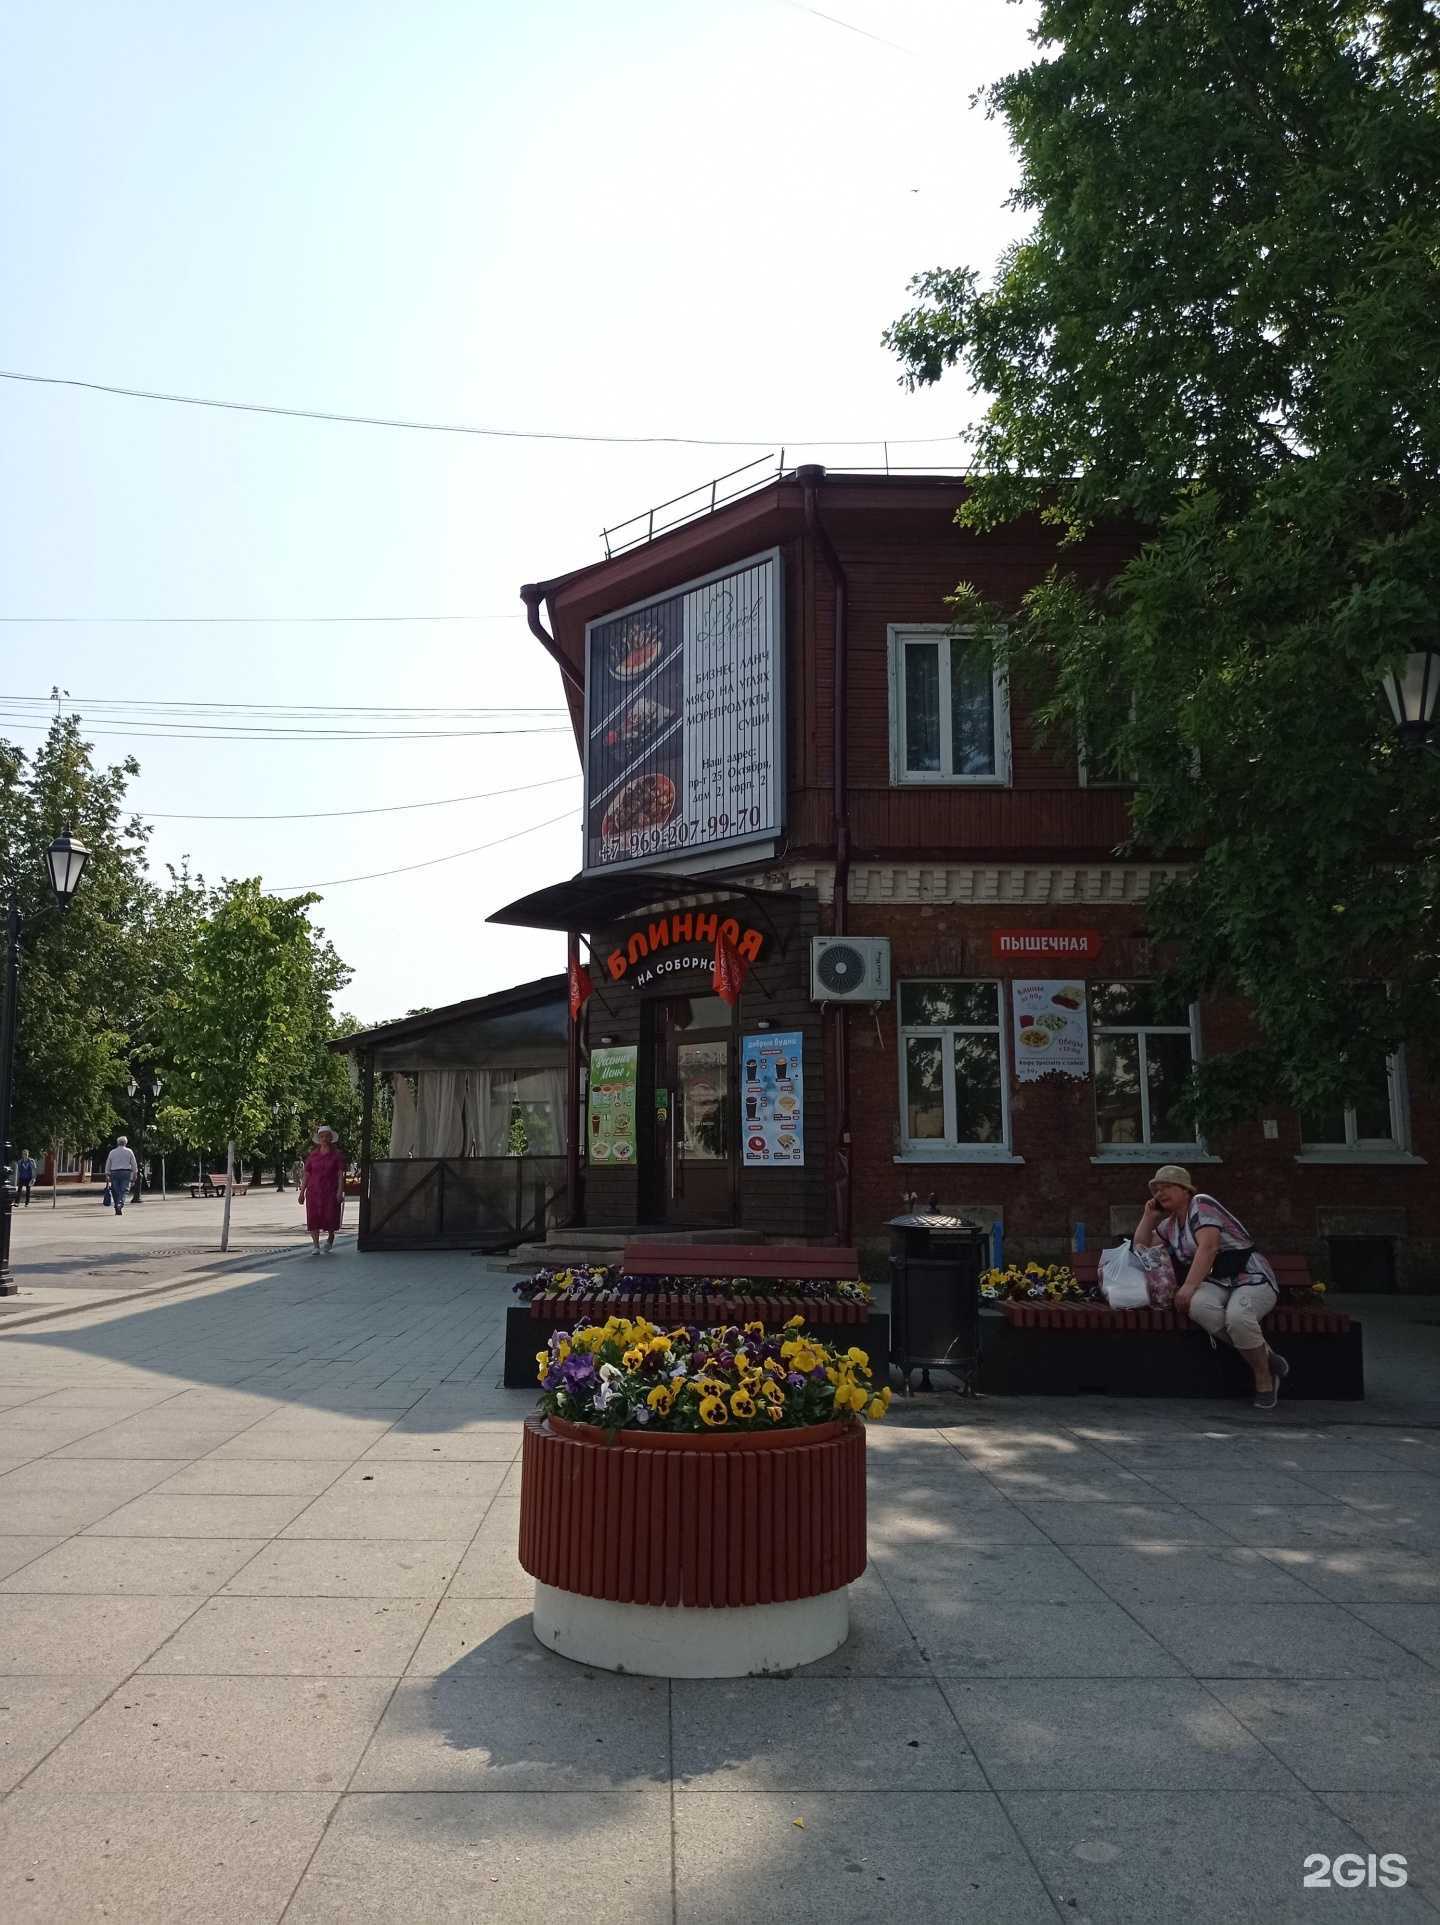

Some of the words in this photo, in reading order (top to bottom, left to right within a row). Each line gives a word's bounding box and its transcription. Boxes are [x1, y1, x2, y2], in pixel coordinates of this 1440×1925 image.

[696, 662, 735, 684] БИЗНЕС
[740, 650, 769, 669] ЛАНЧ
[686, 689, 715, 708] МЯСО
[719, 683, 735, 696] НА
[739, 670, 769, 689] УГЛЯХ
[686, 691, 769, 727] МОРЕПРОДУКТЫ
[738, 712, 769, 731] СУШИ
[702, 757, 723, 770] Наш
[712, 770, 722, 783] 25
[693, 792, 710, 803] дом
[608, 912, 764, 981] БЛИННАЯ
[1000, 936, 1089, 952] ПЫШЕЧНАЯ
[637, 968, 654, 987] НА
[656, 956, 717, 976] СОБОРНО
